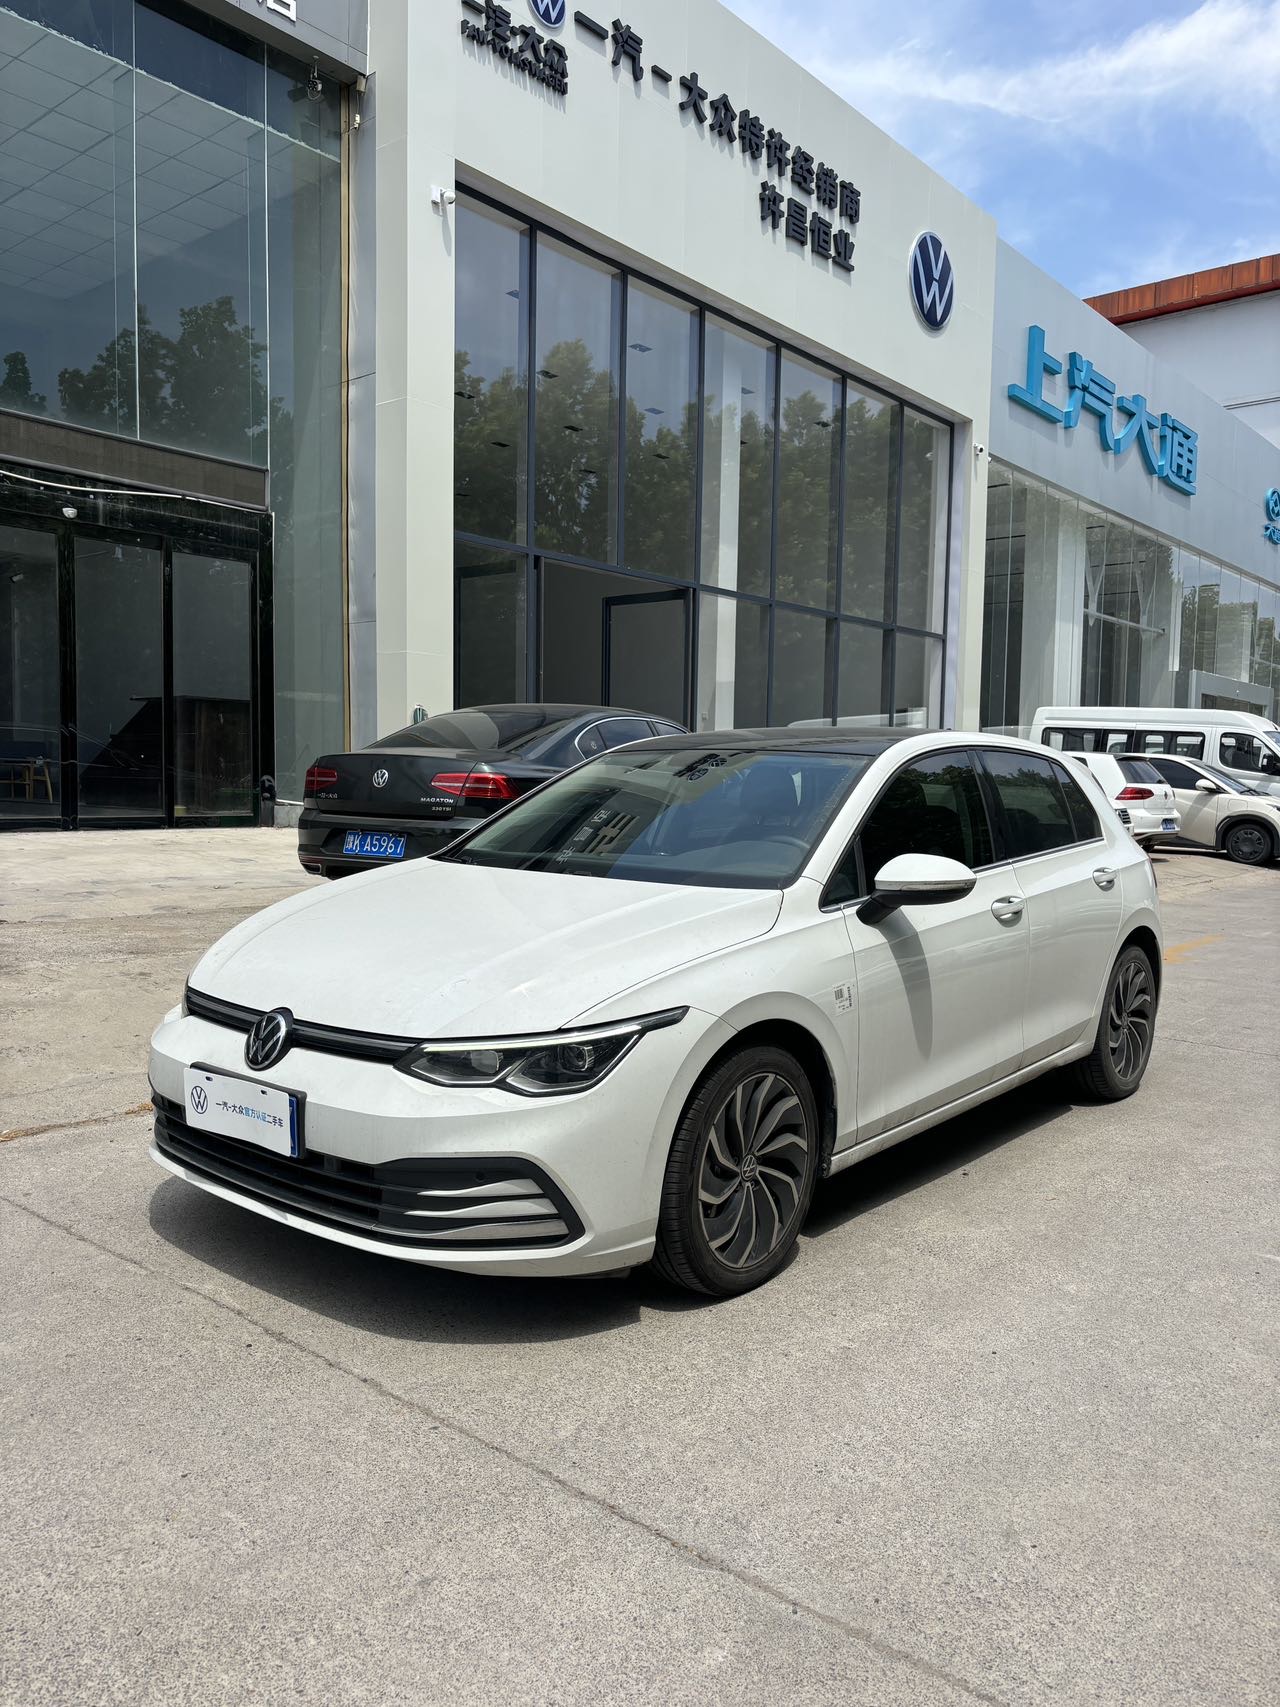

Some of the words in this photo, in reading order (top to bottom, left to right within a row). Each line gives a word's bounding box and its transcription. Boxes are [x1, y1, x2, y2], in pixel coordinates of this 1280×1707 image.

[759, 181, 855, 272] 许昌恒业
[1008, 325, 1198, 495] 上汽大通
